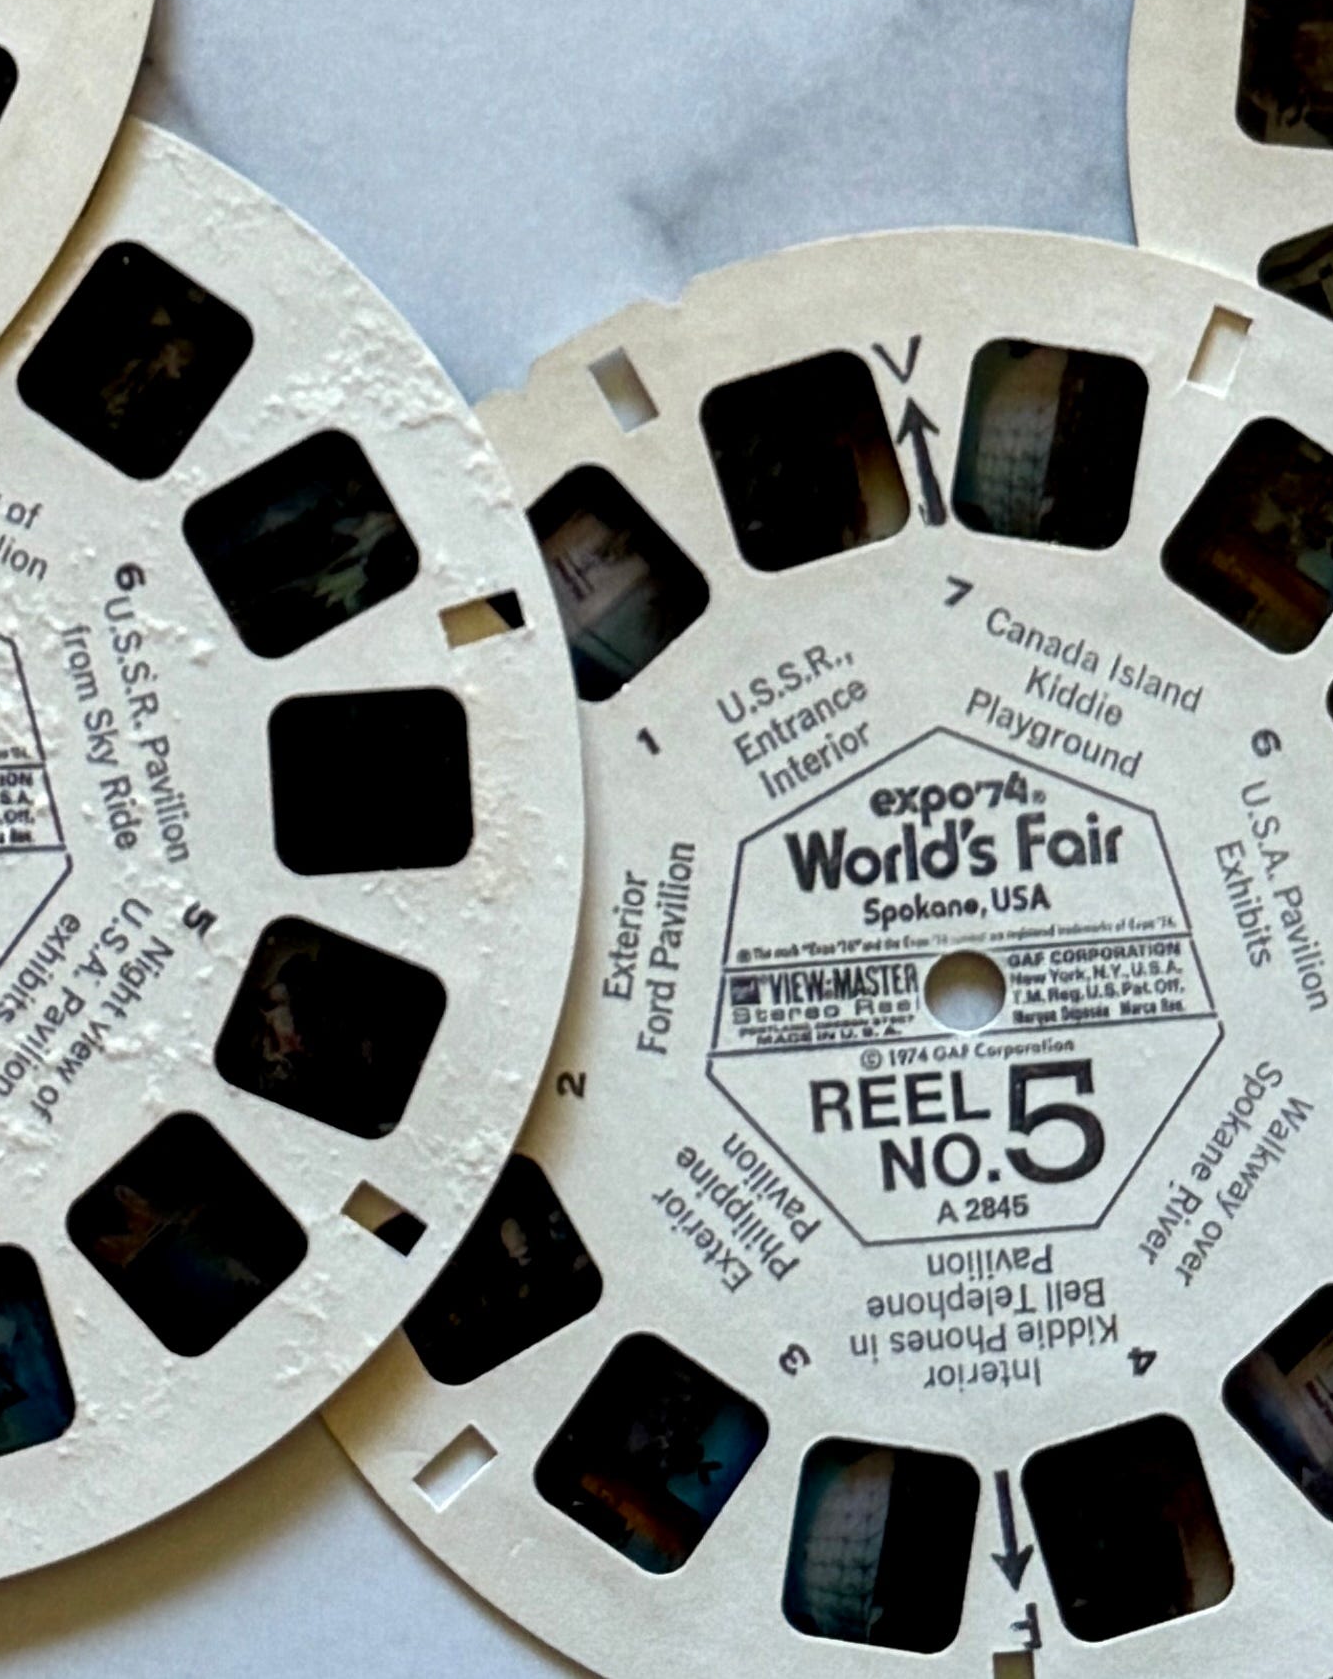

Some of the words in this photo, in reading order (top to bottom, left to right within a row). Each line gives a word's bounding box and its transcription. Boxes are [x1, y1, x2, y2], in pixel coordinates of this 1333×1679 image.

[5, 502, 42, 529] of
[986, 607, 1099, 673] Canada
[1108, 654, 1202, 713] Island
[1024, 665, 1122, 726] Kiddie
[965, 687, 1143, 778] Playground
[785, 818, 997, 892] World's
[1016, 812, 1122, 870] Fair
[864, 893, 986, 931] Spokane,
[991, 883, 1050, 911] USA
[1215, 839, 1272, 967] Exhibits
[1241, 780, 1289, 880] U.S.A.
[1273, 885, 1328, 1011] Pavilion
[810, 1070, 990, 1132] REEL
[880, 1132, 999, 1191] NO.
[1005, 1058, 1105, 1183] 5
[937, 1200, 957, 1223] A
[965, 1194, 1028, 1220] 2845
